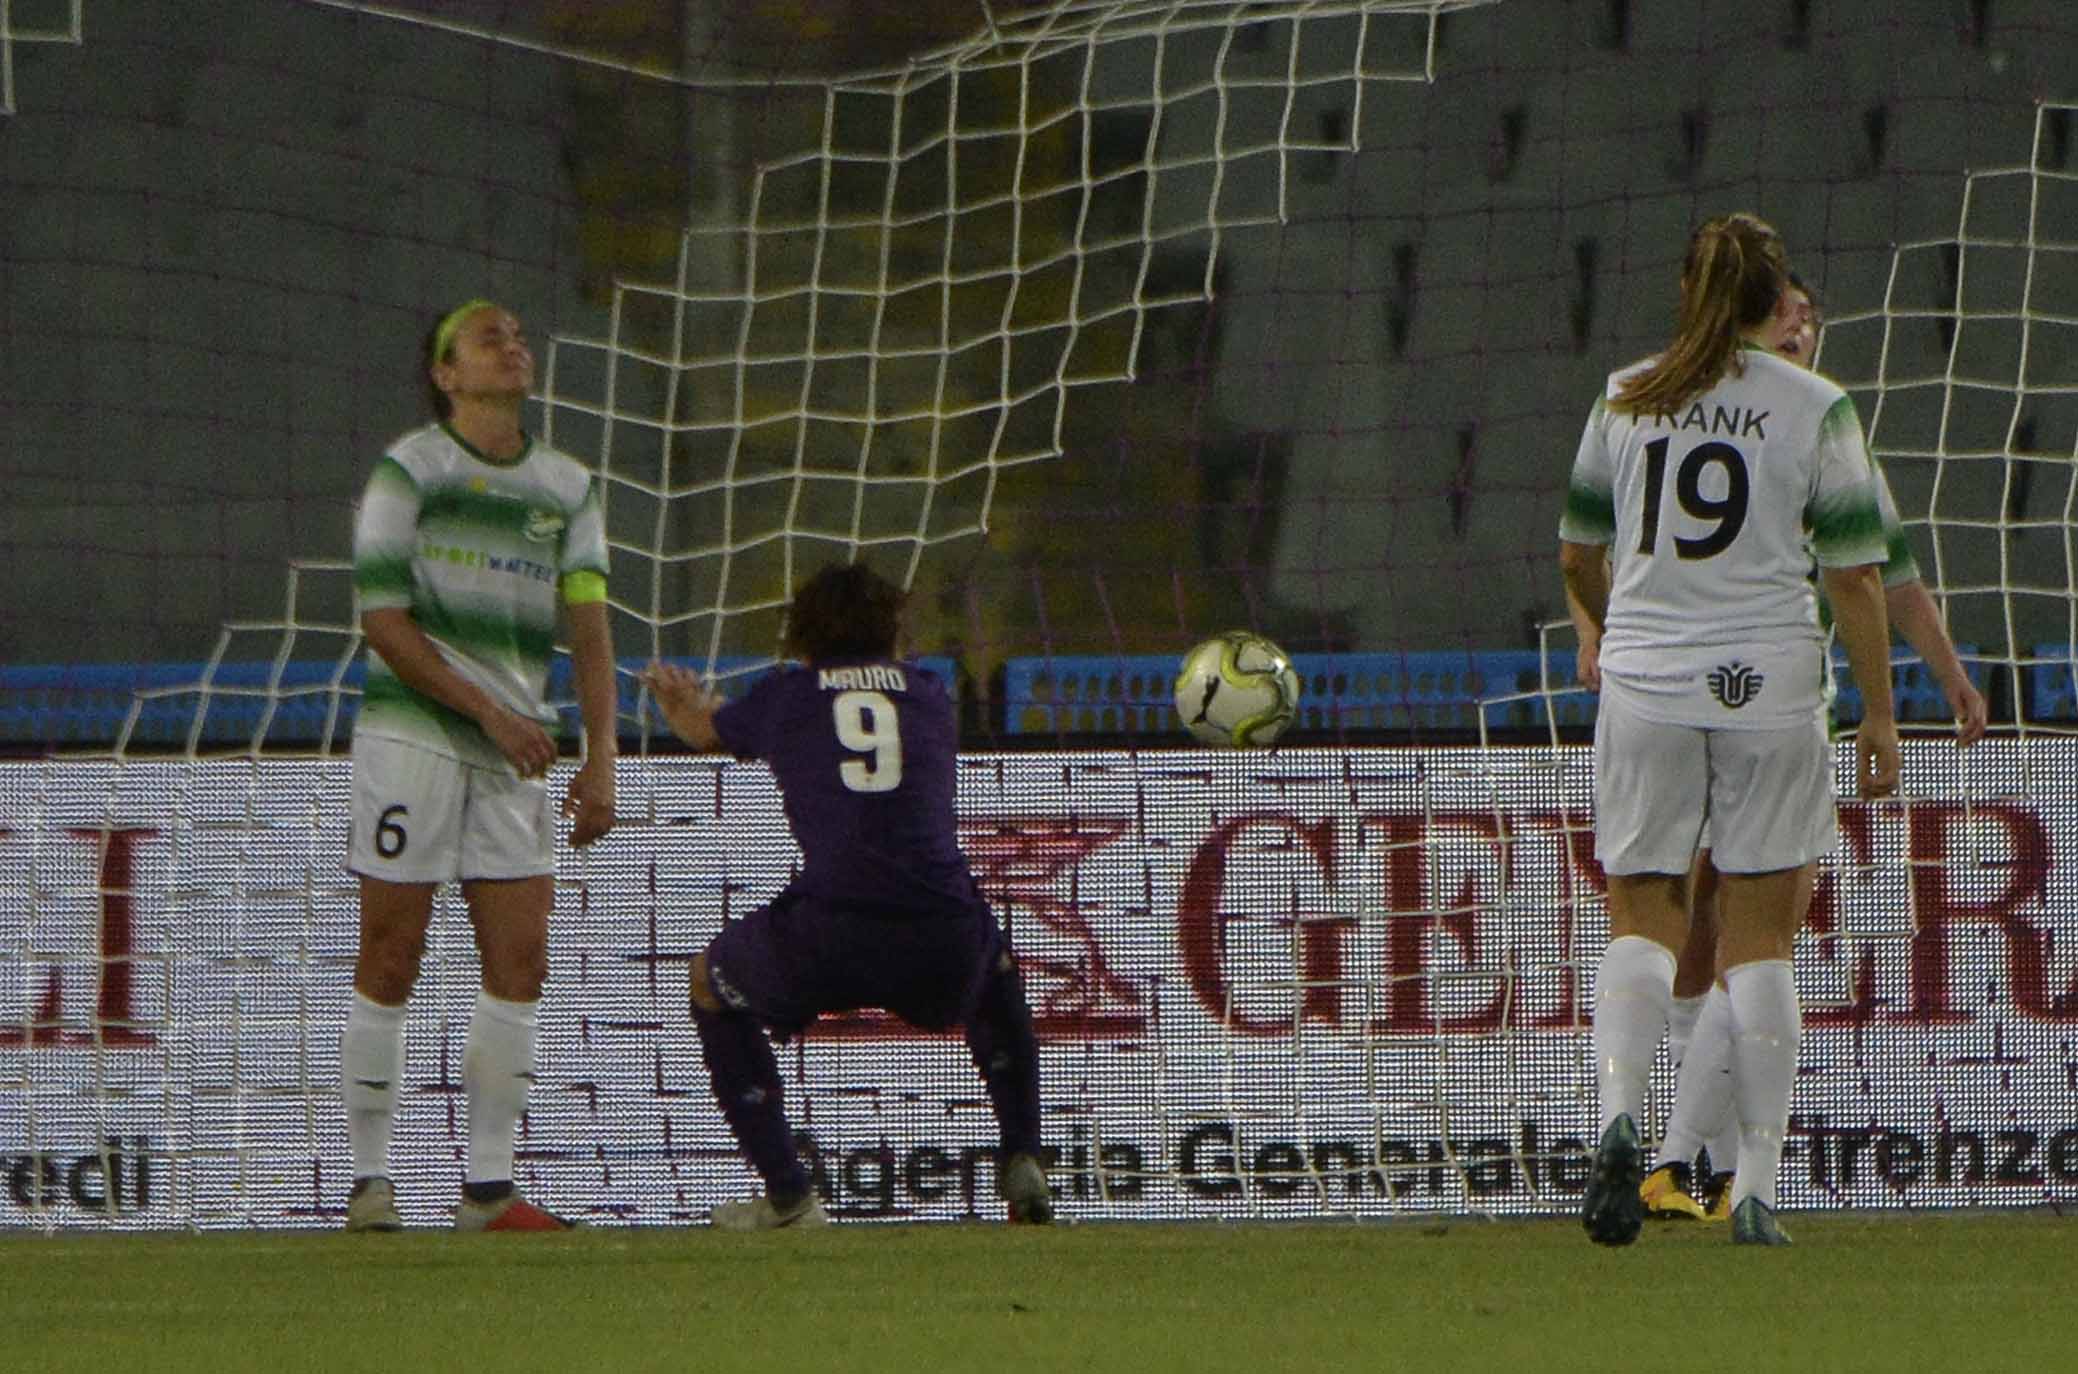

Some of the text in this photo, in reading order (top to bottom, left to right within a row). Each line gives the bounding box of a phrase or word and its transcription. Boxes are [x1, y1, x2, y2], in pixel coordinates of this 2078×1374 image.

[1637, 436, 1750, 560] 19
[818, 666, 907, 692] MAURO
[833, 691, 903, 792] 9
[376, 805, 409, 859] 6
[0, 1134, 150, 1208] edi
[1178, 1120, 1596, 1198] Generale
[1783, 1115, 2078, 1188] irenze
